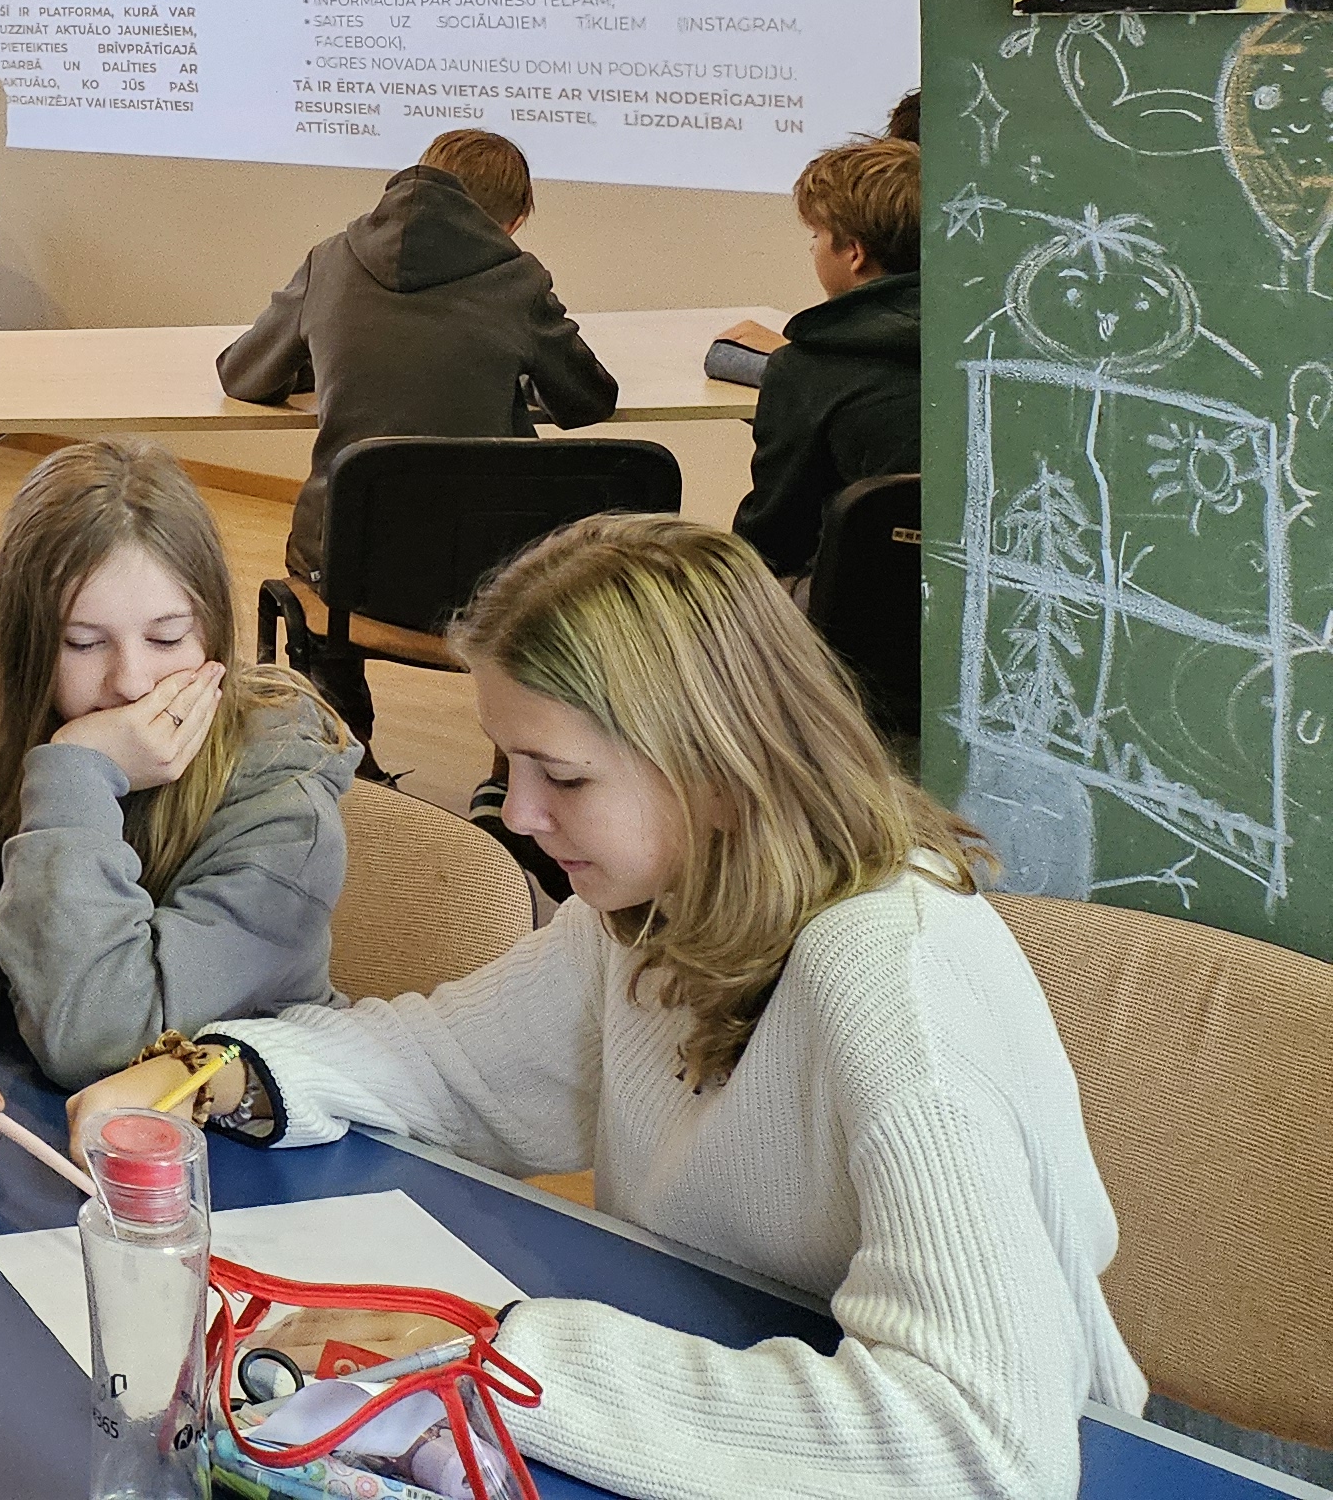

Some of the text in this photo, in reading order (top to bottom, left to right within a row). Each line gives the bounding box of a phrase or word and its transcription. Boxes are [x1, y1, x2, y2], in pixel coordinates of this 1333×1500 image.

[18, 6, 30, 17] IR
[38, 6, 115, 19] PLATFORMA,
[123, 4, 159, 18] KURĀ
[168, 6, 197, 18] VAR
[0, 22, 197, 38] UZZINĀT AKTUĀLO JAUNIEŠIEM,
[313, 14, 365, 28] SAITES
[389, 15, 412, 29] UZ
[436, 13, 548, 30] SOCIĀLAJIEM
[576, 14, 647, 32] TĪKLIEM
[0, 41, 198, 56] PIETEIKTIES BRĪVPRĀTĪGAJĀ
[1, 58, 198, 74] DARBĀ UN DALĪTIES AR
[315, 56, 367, 70] OGRES
[371, 57, 437, 72] NOVADA
[440, 56, 521, 74] JAUNIEŠU
[526, 59, 572, 75] DOMI
[577, 61, 603, 76] UN
[609, 60, 707, 79] PODKĀSTU
[2, 77, 199, 93] AKTUĀLO, KO JŪS PAŠI
[292, 77, 804, 109] TĀ IR ĒRTA VIENAS VIETAS SAITE AR VISIEM NODERĪGAJIEM
[86, 97, 107, 109] VAI
[294, 101, 381, 116] RESURSIEM
[403, 104, 484, 119] JAUNIEŠU
[774, 118, 804, 134] UN
